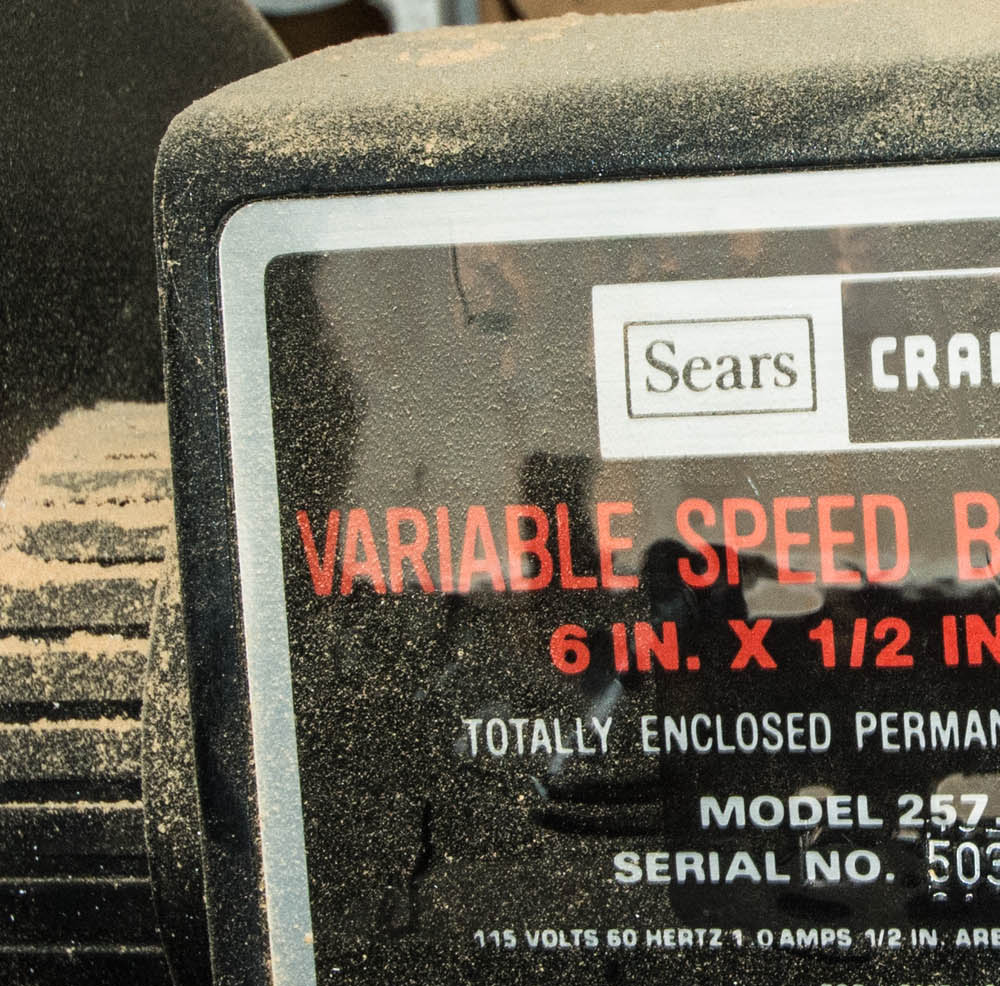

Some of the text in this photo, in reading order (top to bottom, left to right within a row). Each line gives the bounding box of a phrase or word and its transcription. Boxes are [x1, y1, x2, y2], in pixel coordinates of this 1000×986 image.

[645, 339, 799, 395] Sears
[296, 501, 639, 597] VARIABLE
[676, 494, 911, 588] SPEED
[550, 623, 590, 674] 6
[611, 620, 700, 674] IN.
[729, 618, 778, 670] X
[808, 615, 915, 669] 1/2
[464, 715, 615, 757] TOTALLY
[641, 711, 832, 754] ENCLOSED
[700, 794, 884, 829] MODEL
[613, 850, 791, 883] SERIAL
[804, 848, 896, 884] NO.
[474, 929, 516, 948] 115
[525, 928, 599, 949] VOLTS
[607, 929, 637, 948] 60
[646, 928, 722, 948] HERTZ
[780, 928, 853, 948] AMPS
[865, 928, 901, 948] 1/2
[910, 928, 945, 948] IN.
